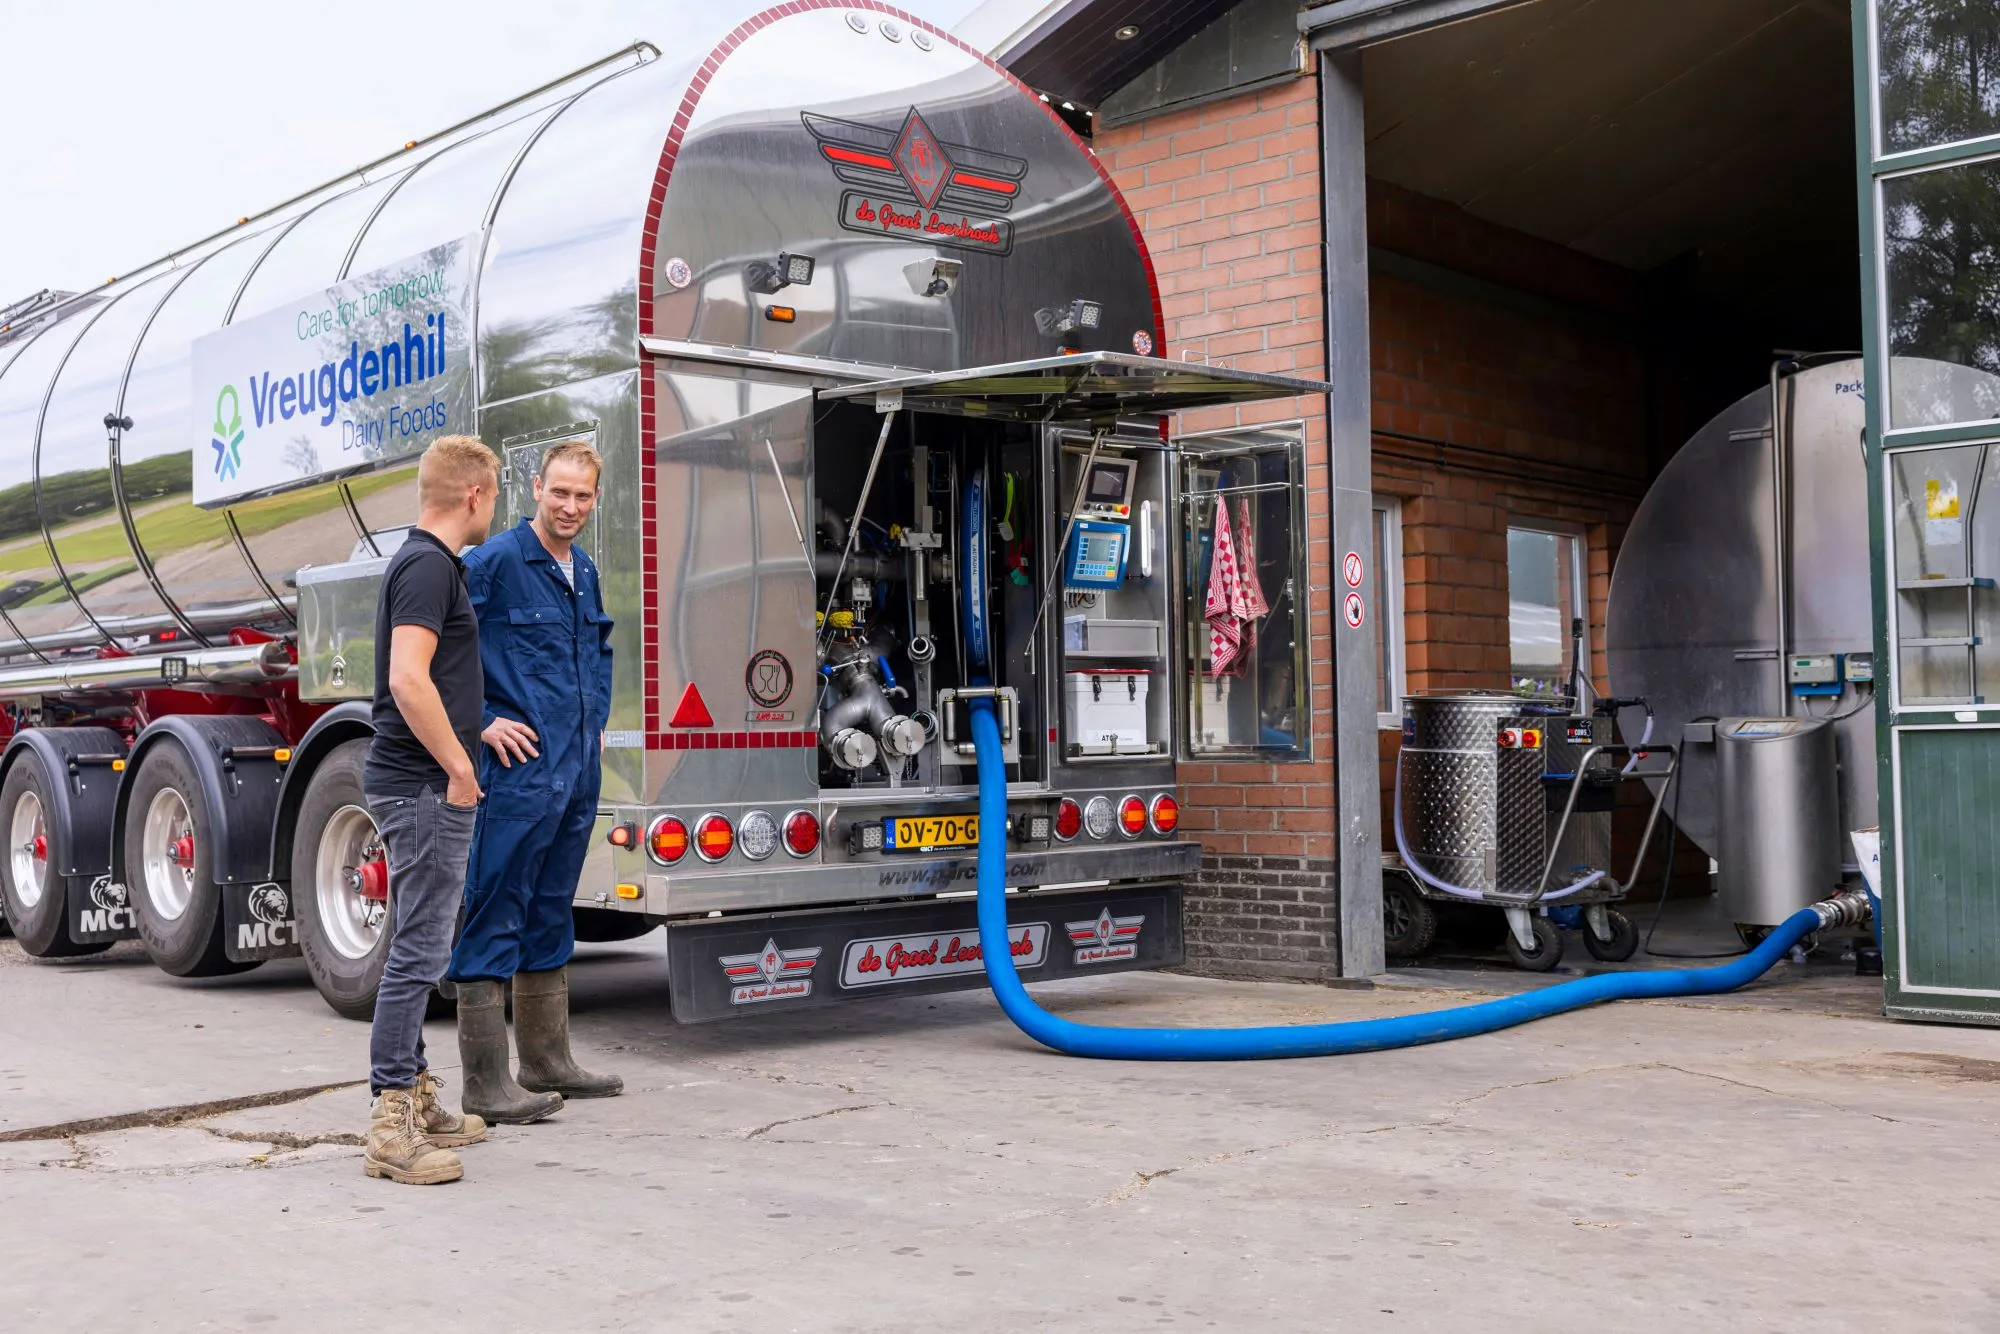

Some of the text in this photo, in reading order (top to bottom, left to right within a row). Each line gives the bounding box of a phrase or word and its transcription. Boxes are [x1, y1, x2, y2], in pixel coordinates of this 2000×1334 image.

[855, 199, 999, 244] de Groot Leerbroek
[297, 268, 444, 341] Care for tomorrow
[250, 311, 446, 428] Vreugdenhil
[1835, 379, 1865, 395] Pack
[342, 395, 446, 451] Dairy Foods
[886, 836, 895, 844] NL
[900, 819, 979, 845] OV-70-G
[858, 929, 1034, 977] de Groot Leerek
